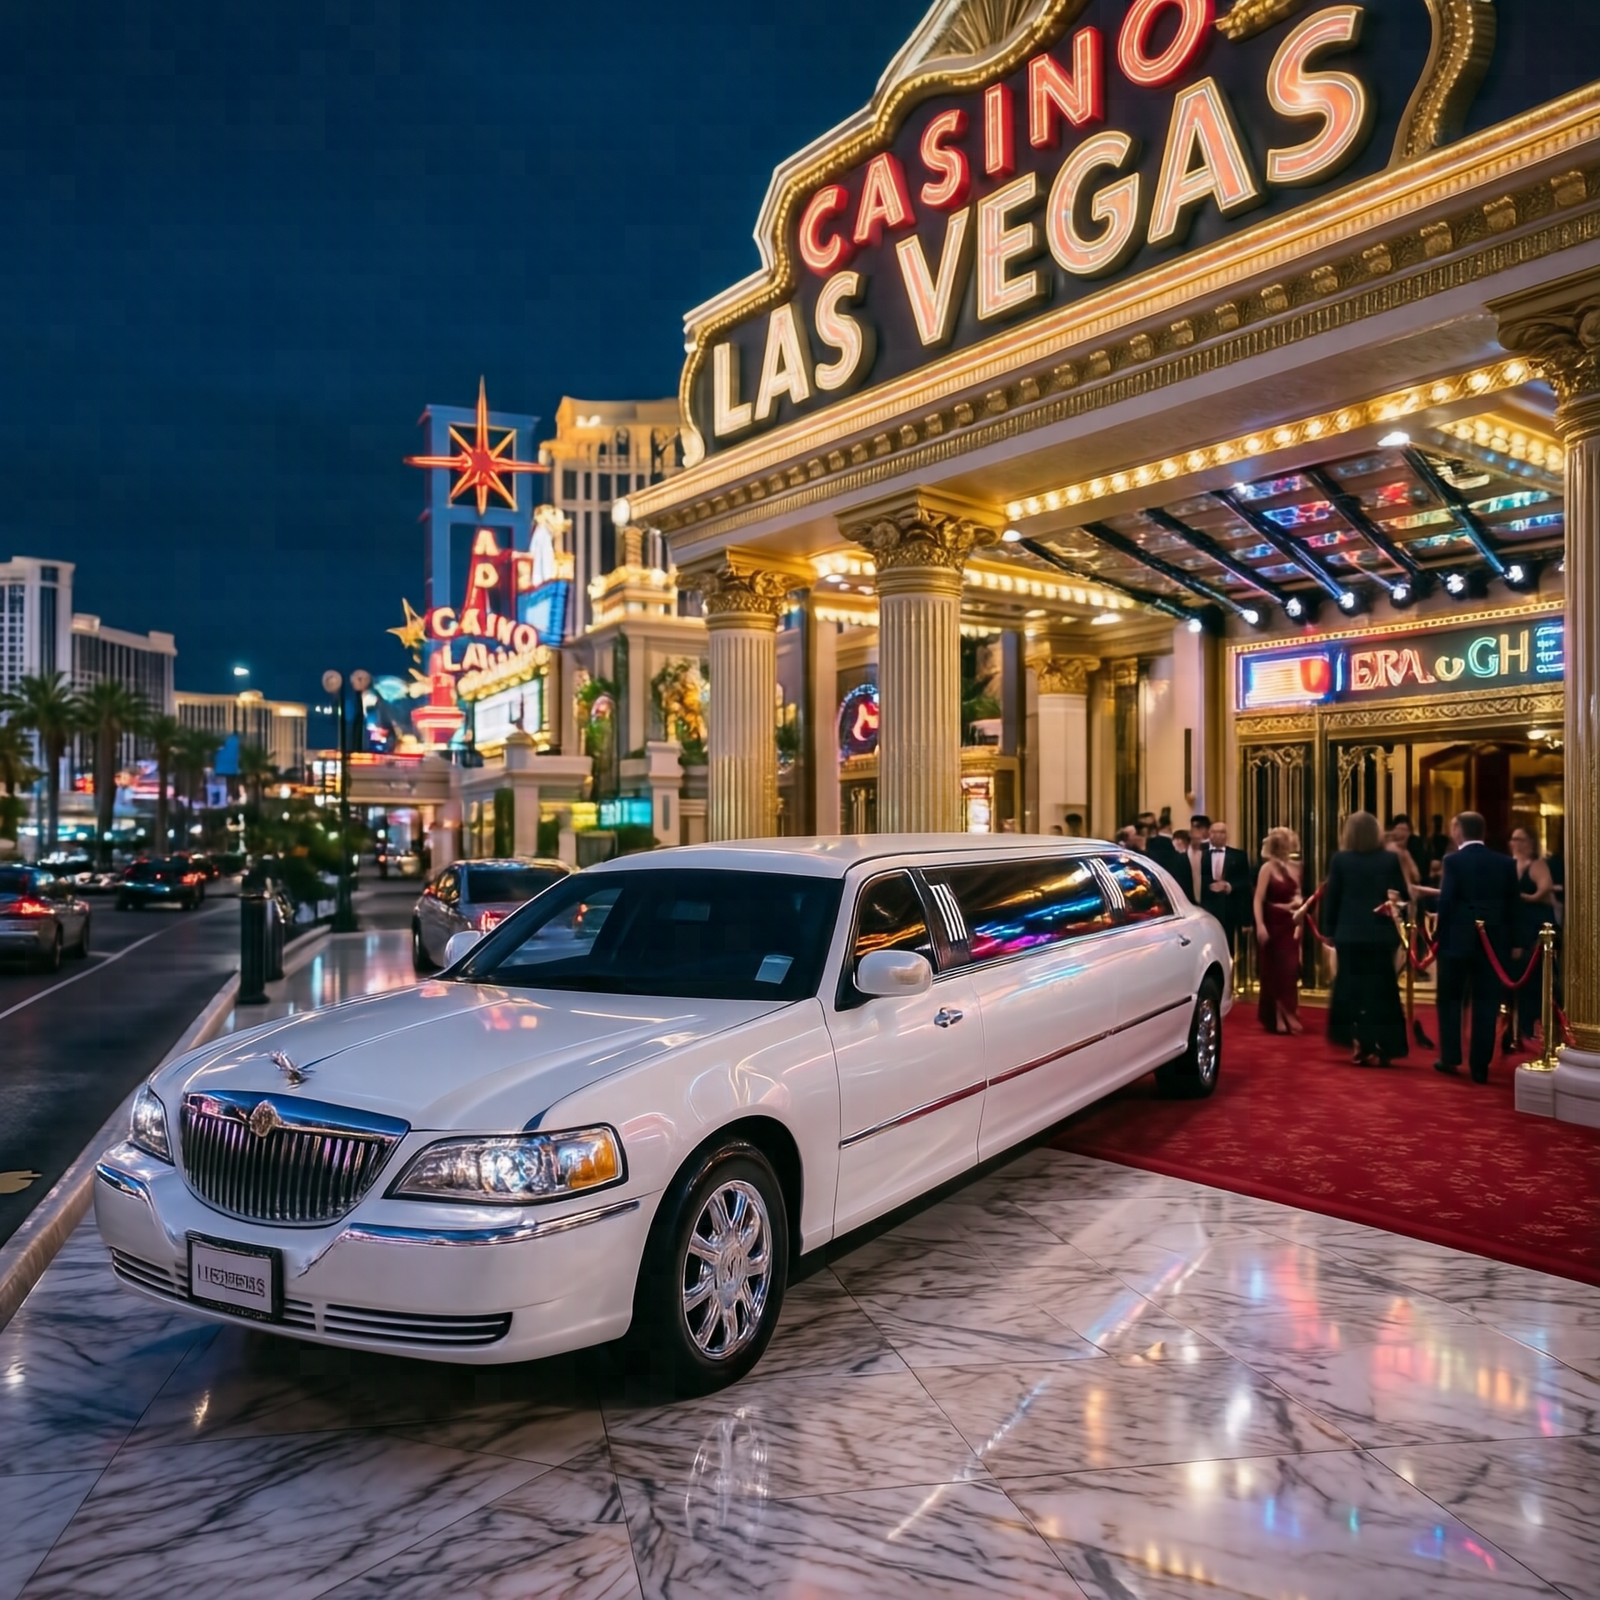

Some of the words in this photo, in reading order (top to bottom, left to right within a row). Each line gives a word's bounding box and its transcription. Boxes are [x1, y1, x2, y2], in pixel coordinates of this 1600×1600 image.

[713, 272, 864, 436] LAS
[896, 6, 1365, 346] VEGAS
[800, 0, 1210, 272] CASINO
